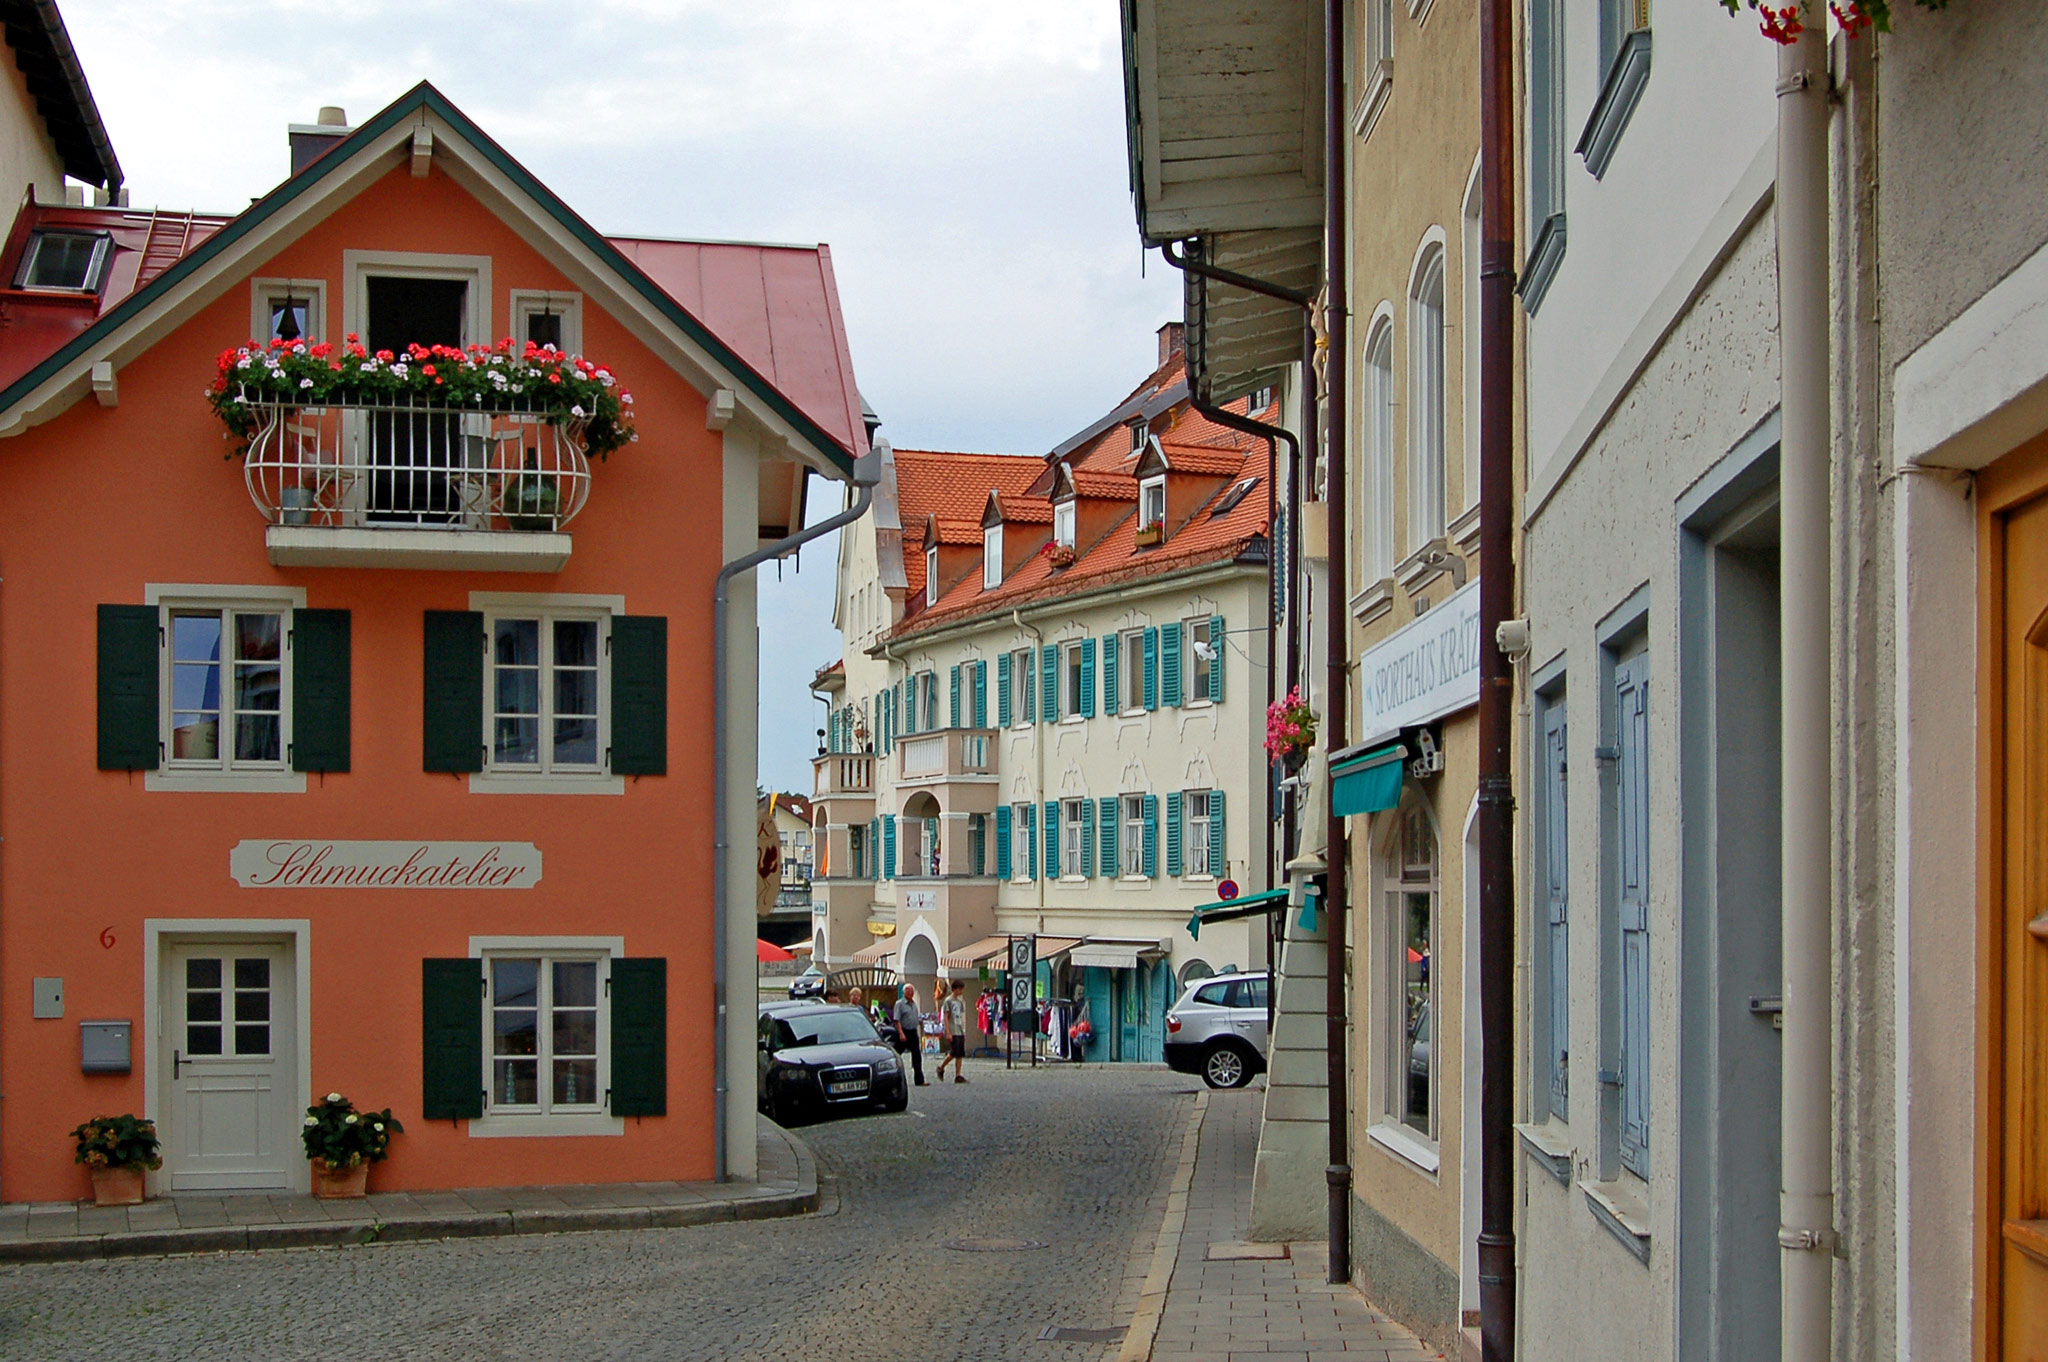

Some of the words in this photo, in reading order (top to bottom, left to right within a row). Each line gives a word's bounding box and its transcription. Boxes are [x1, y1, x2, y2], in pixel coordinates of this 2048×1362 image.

[1375, 640, 1435, 716] SPORTHAUS
[250, 842, 525, 885] Schmuckatelier
[100, 926, 116, 949] 6
